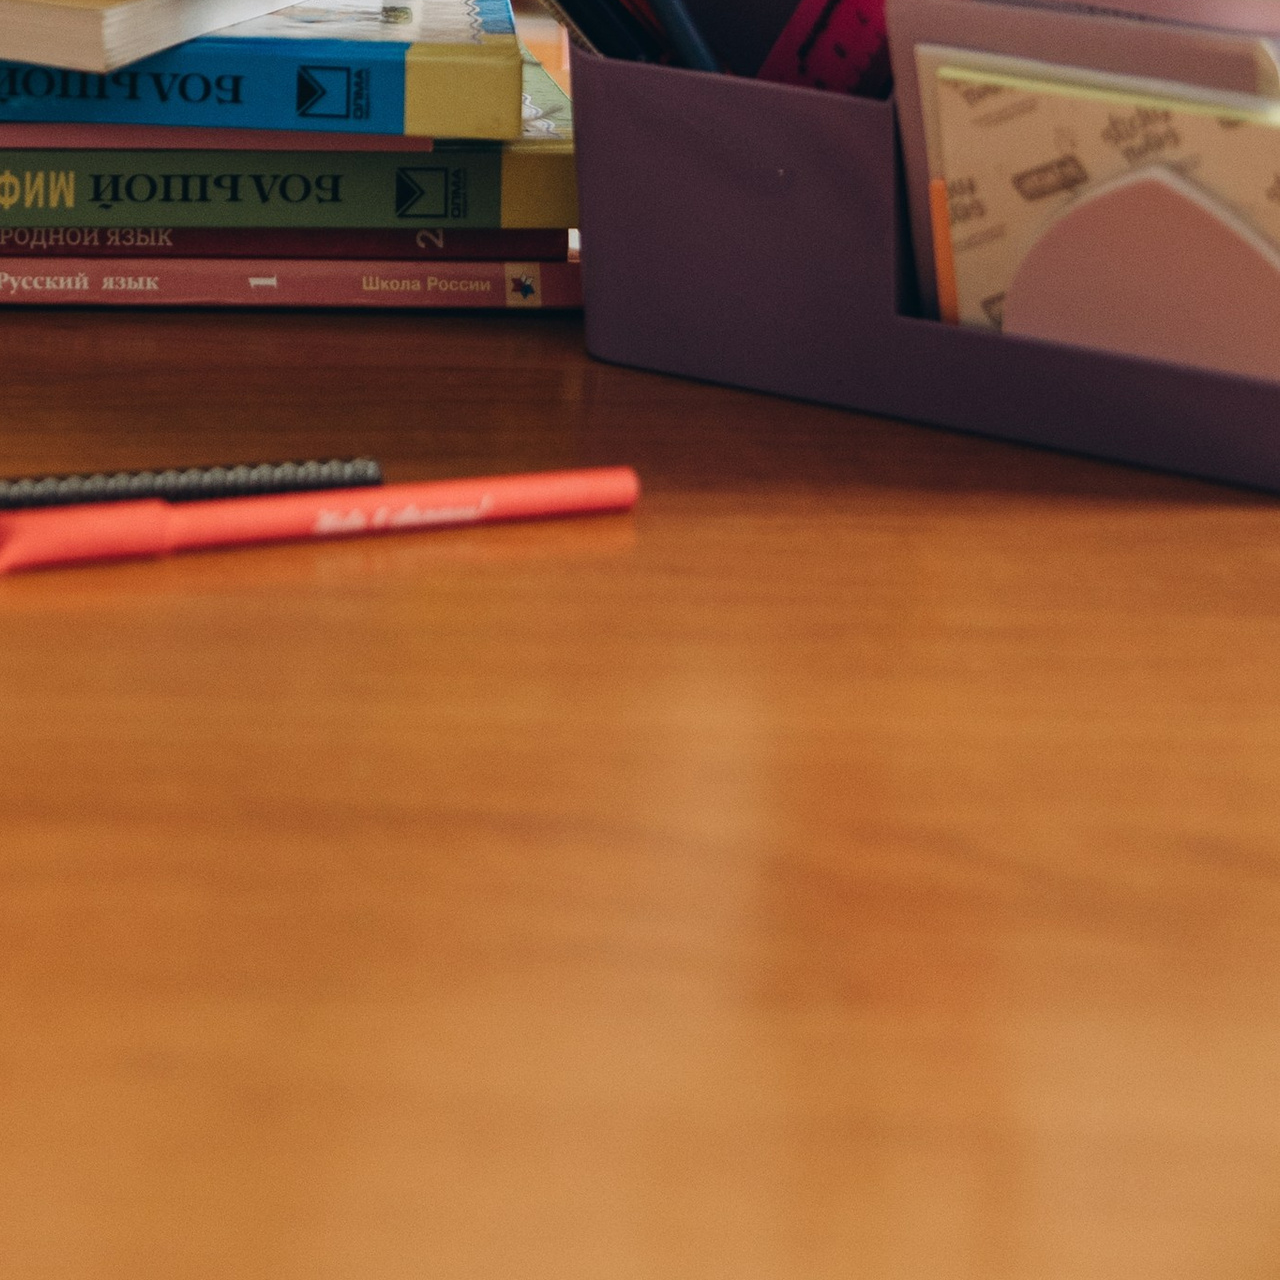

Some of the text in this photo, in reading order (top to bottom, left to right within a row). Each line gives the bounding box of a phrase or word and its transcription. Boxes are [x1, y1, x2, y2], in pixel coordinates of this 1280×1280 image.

[88, 172, 343, 211] БОЛЬШОЙ
[106, 227, 174, 247] ЯЗЫК
[416, 227, 444, 250] 2
[101, 274, 160, 294] язык
[248, 275, 278, 289] 1
[362, 275, 492, 293] Школа России
